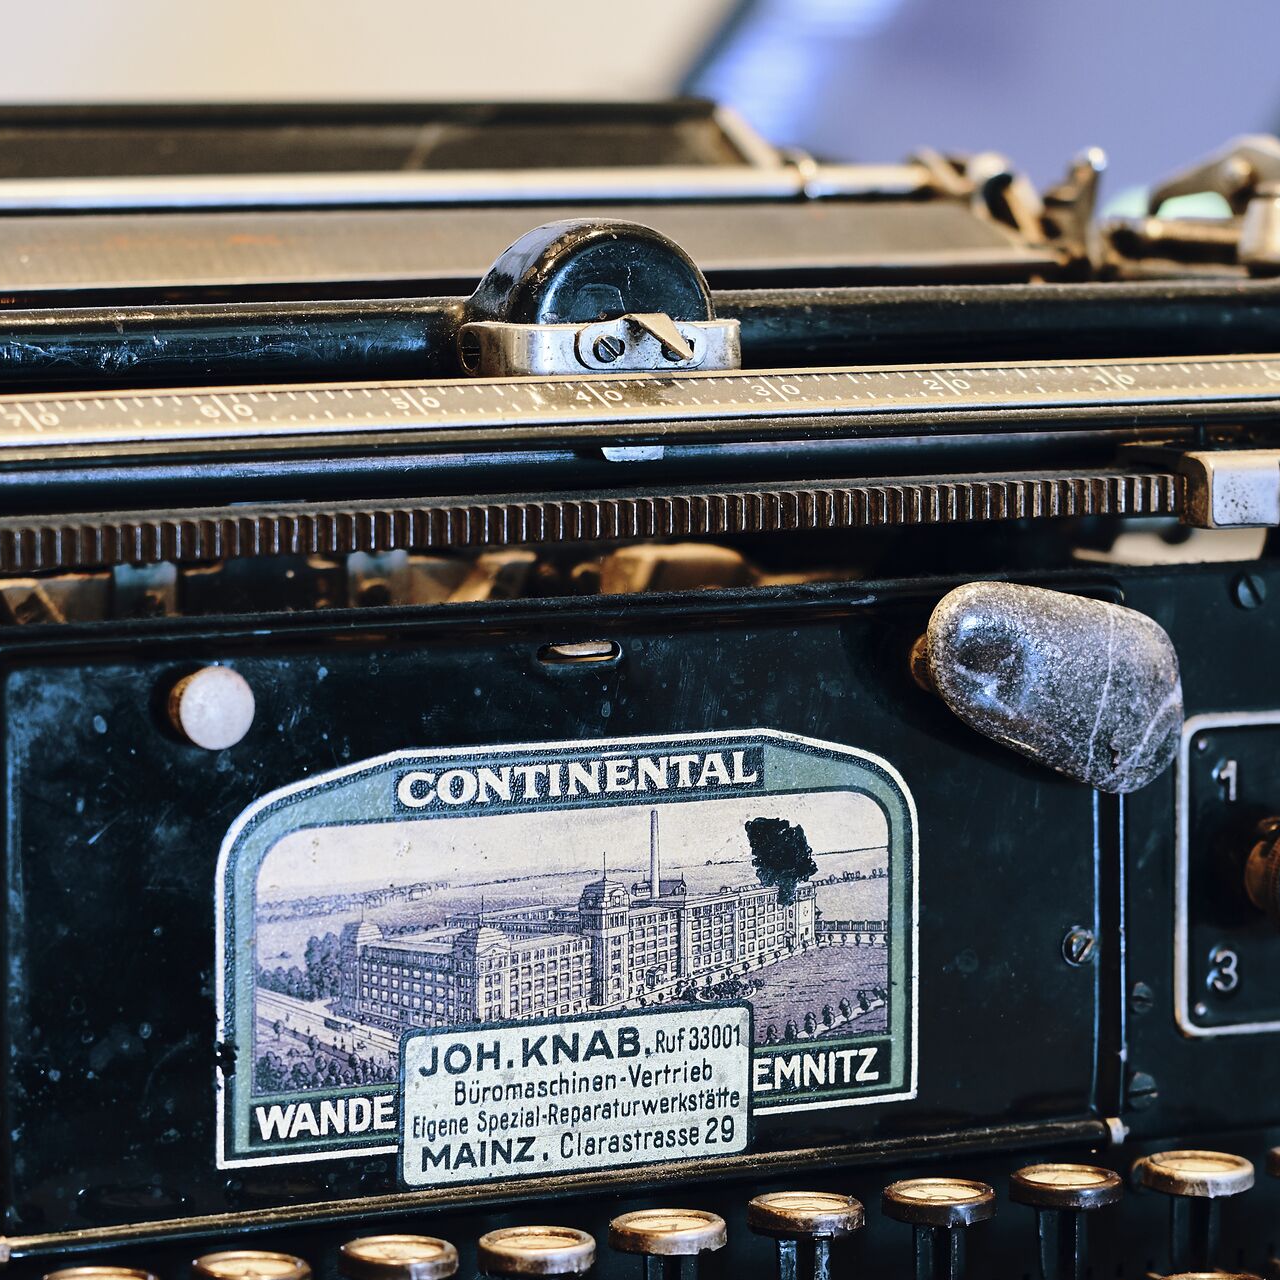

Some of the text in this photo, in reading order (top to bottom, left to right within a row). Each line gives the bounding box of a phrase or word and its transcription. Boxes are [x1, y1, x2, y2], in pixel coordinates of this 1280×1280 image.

[199, 403, 254, 418] 60
[391, 396, 441, 411] 50
[575, 389, 624, 403] 40
[750, 384, 801, 397] 30
[922, 378, 971, 391] 20
[1093, 373, 1136, 386] 10
[398, 752, 757, 808] CONTINENTAL
[1219, 759, 1238, 801] 1
[1212, 949, 1239, 992] 3
[655, 1027, 686, 1054] Ruf
[689, 1023, 740, 1051] 33001
[255, 1047, 880, 1141] WANDE EMNITZ
[454, 1058, 713, 1106] Büromaschinen-Vertrieb
[412, 1087, 741, 1142] Eigene Spezial-Reparaturwerkstätte
[560, 1126, 700, 1159] Clarastrasse
[704, 1114, 735, 1144] 29
